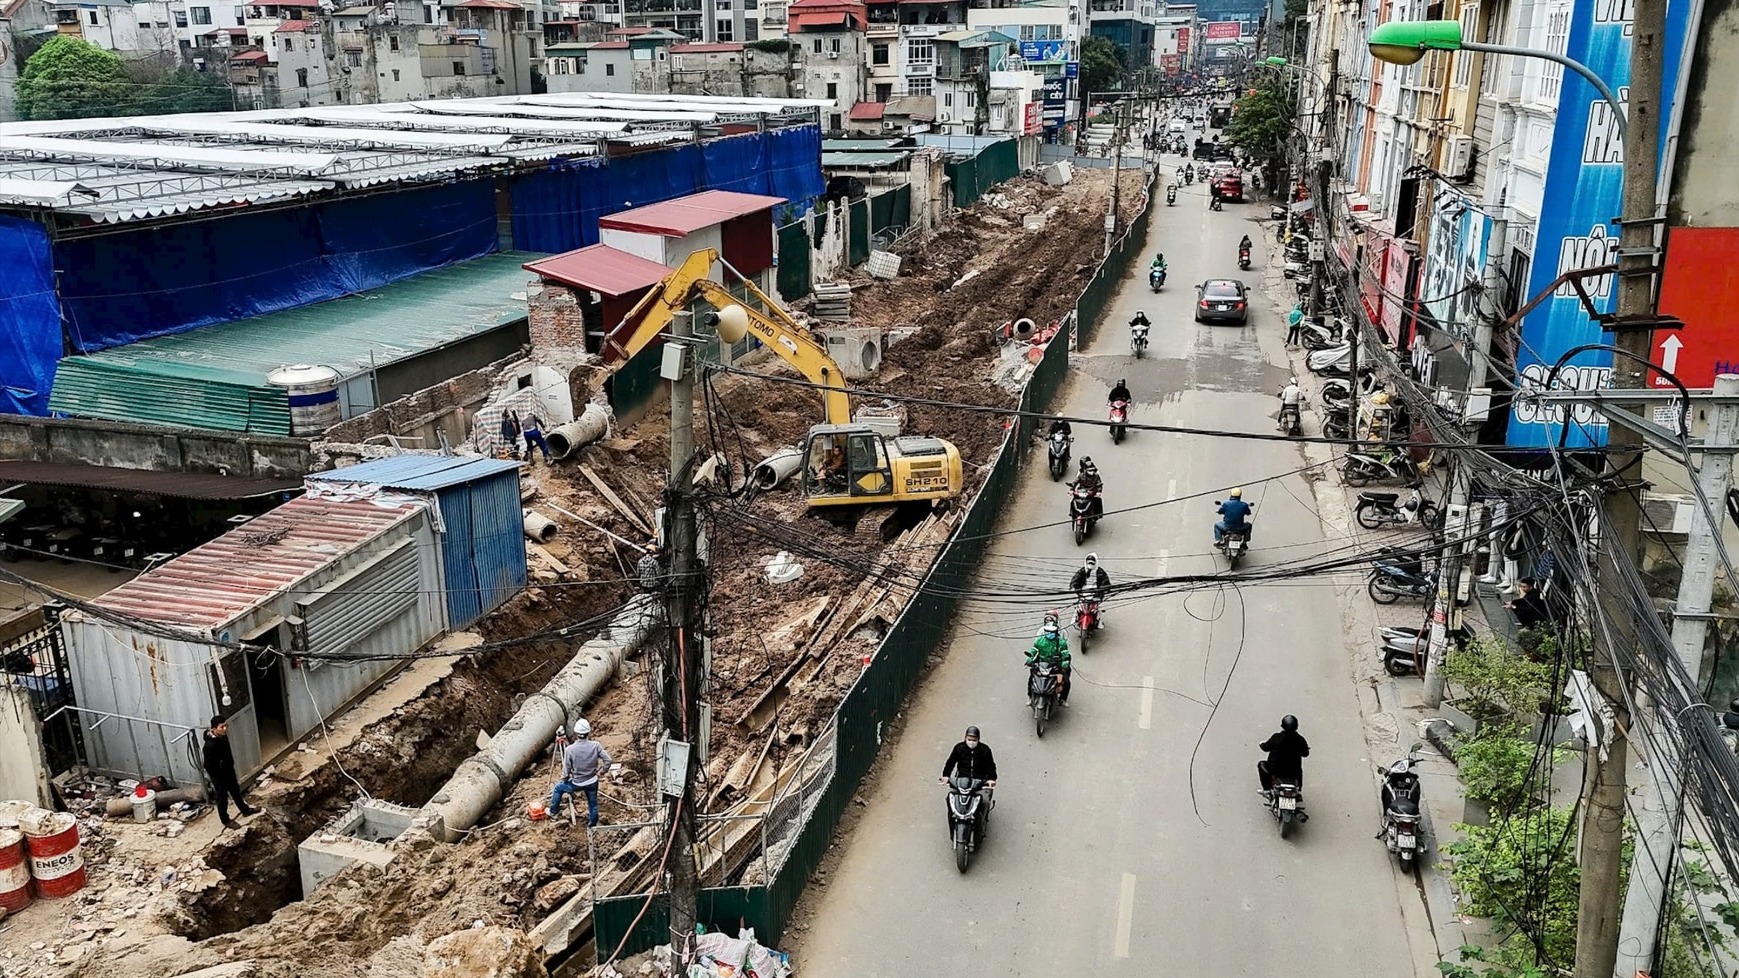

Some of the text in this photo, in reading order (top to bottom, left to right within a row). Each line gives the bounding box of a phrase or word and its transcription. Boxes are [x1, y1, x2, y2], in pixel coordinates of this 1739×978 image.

[748, 314, 775, 338] TOMO
[906, 477, 947, 486] SH210
[36, 853, 74, 869] ENEOS
